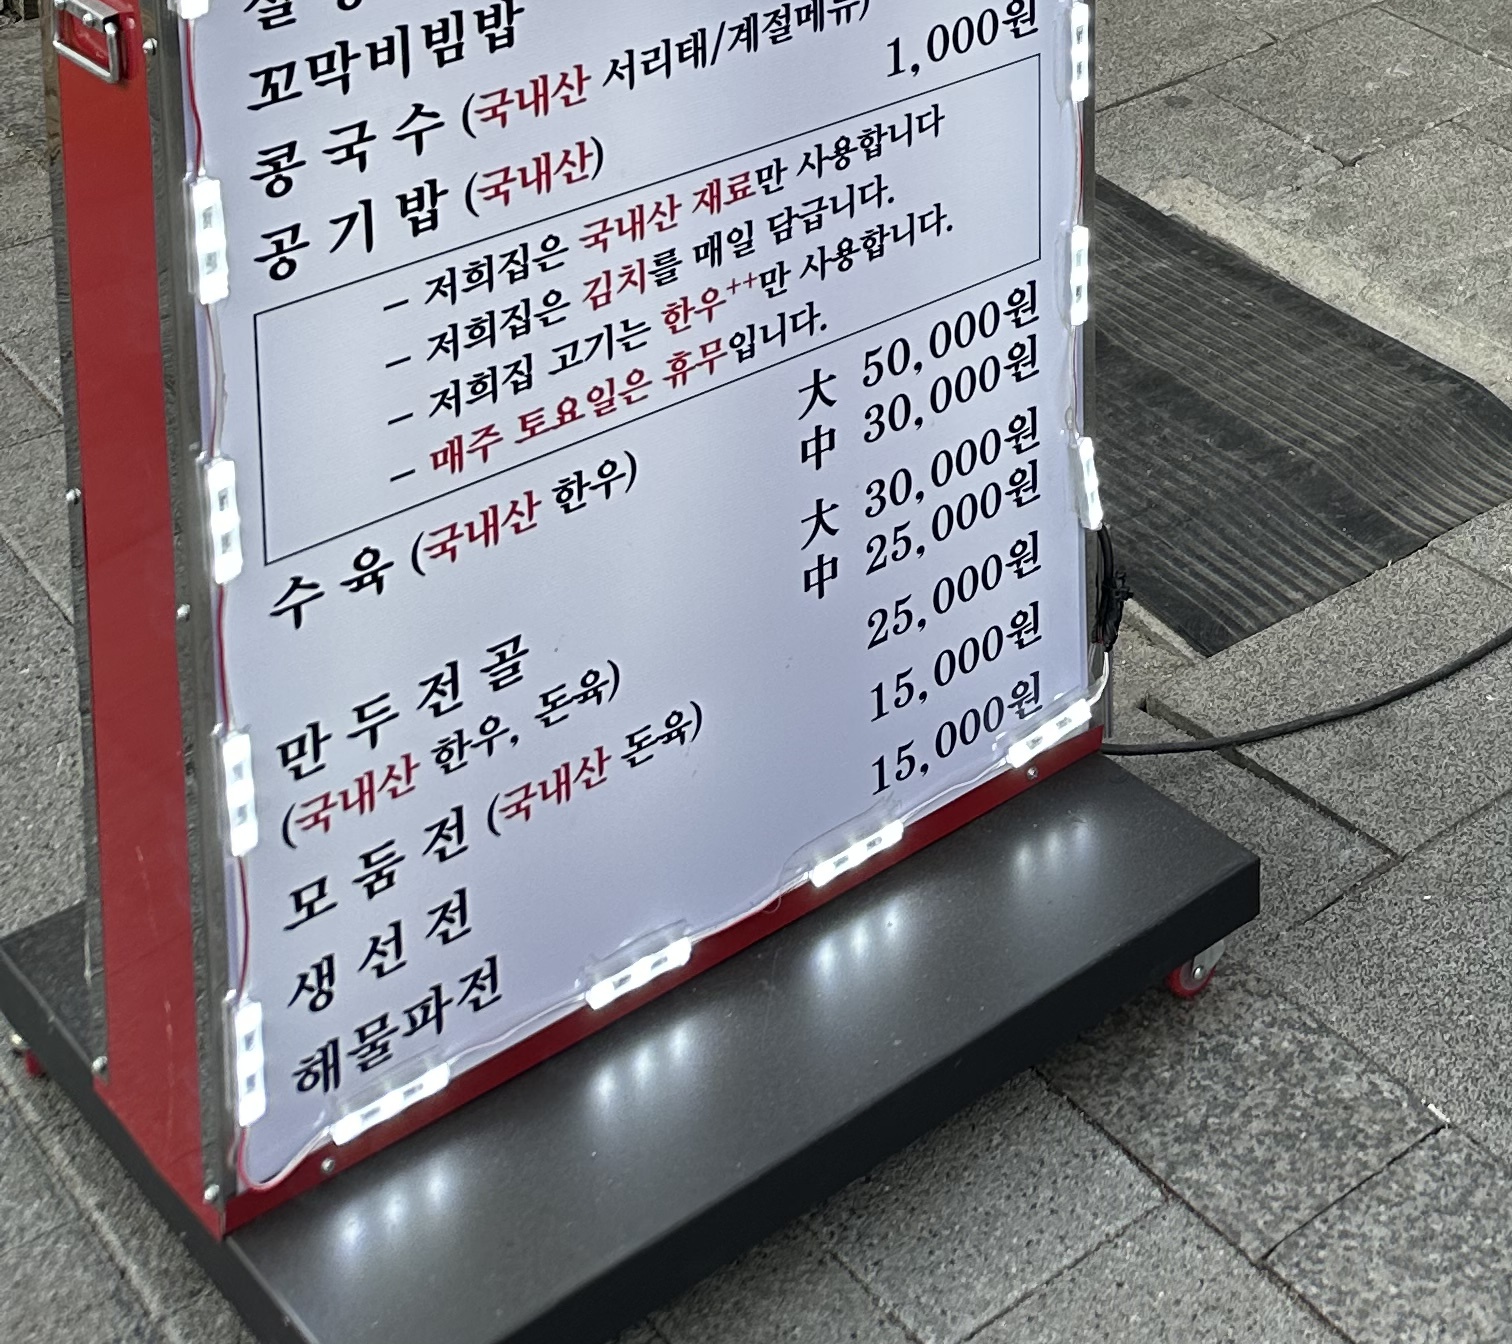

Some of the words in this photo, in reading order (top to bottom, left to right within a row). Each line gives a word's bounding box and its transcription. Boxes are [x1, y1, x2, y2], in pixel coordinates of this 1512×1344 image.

[461, 64, 592, 140] (국내산
[424, 233, 569, 306] 저희집은
[578, 193, 683, 253] 국내산
[692, 157, 789, 215] 재료만
[796, 103, 946, 180] 사용합니다
[465, 135, 605, 218] (국내산)
[426, 288, 571, 362] 저희집은
[582, 247, 684, 311] 김치를
[694, 219, 757, 269] 매일
[428, 352, 534, 419] 저희집
[548, 318, 652, 376] 고기는
[800, 203, 954, 280] 사용합니다.
[798, 368, 838, 420] 大
[862, 280, 1040, 387] 50,000원
[429, 424, 504, 474] 매주
[514, 368, 654, 444] 토요일은
[662, 301, 828, 390] 휴무입니다.
[801, 424, 836, 471] 中
[864, 334, 1040, 444] 30,000원
[411, 490, 542, 575] (국내산
[552, 450, 637, 514] 한우)
[800, 498, 840, 550] 大
[864, 406, 1041, 517] 30,000원
[803, 553, 839, 600] 中
[865, 459, 1041, 575] 25,000원
[487, 746, 613, 837] (국내산
[620, 700, 703, 768] 돈육)
[867, 530, 1042, 650] 25,000원
[870, 601, 1042, 723] 15,000원
[281, 753, 420, 850] (국내산
[430, 714, 520, 776] 한우,
[535, 659, 622, 729] 돈육)
[292, 955, 503, 1095] 해물파전
[871, 670, 1044, 796] 15,000원
